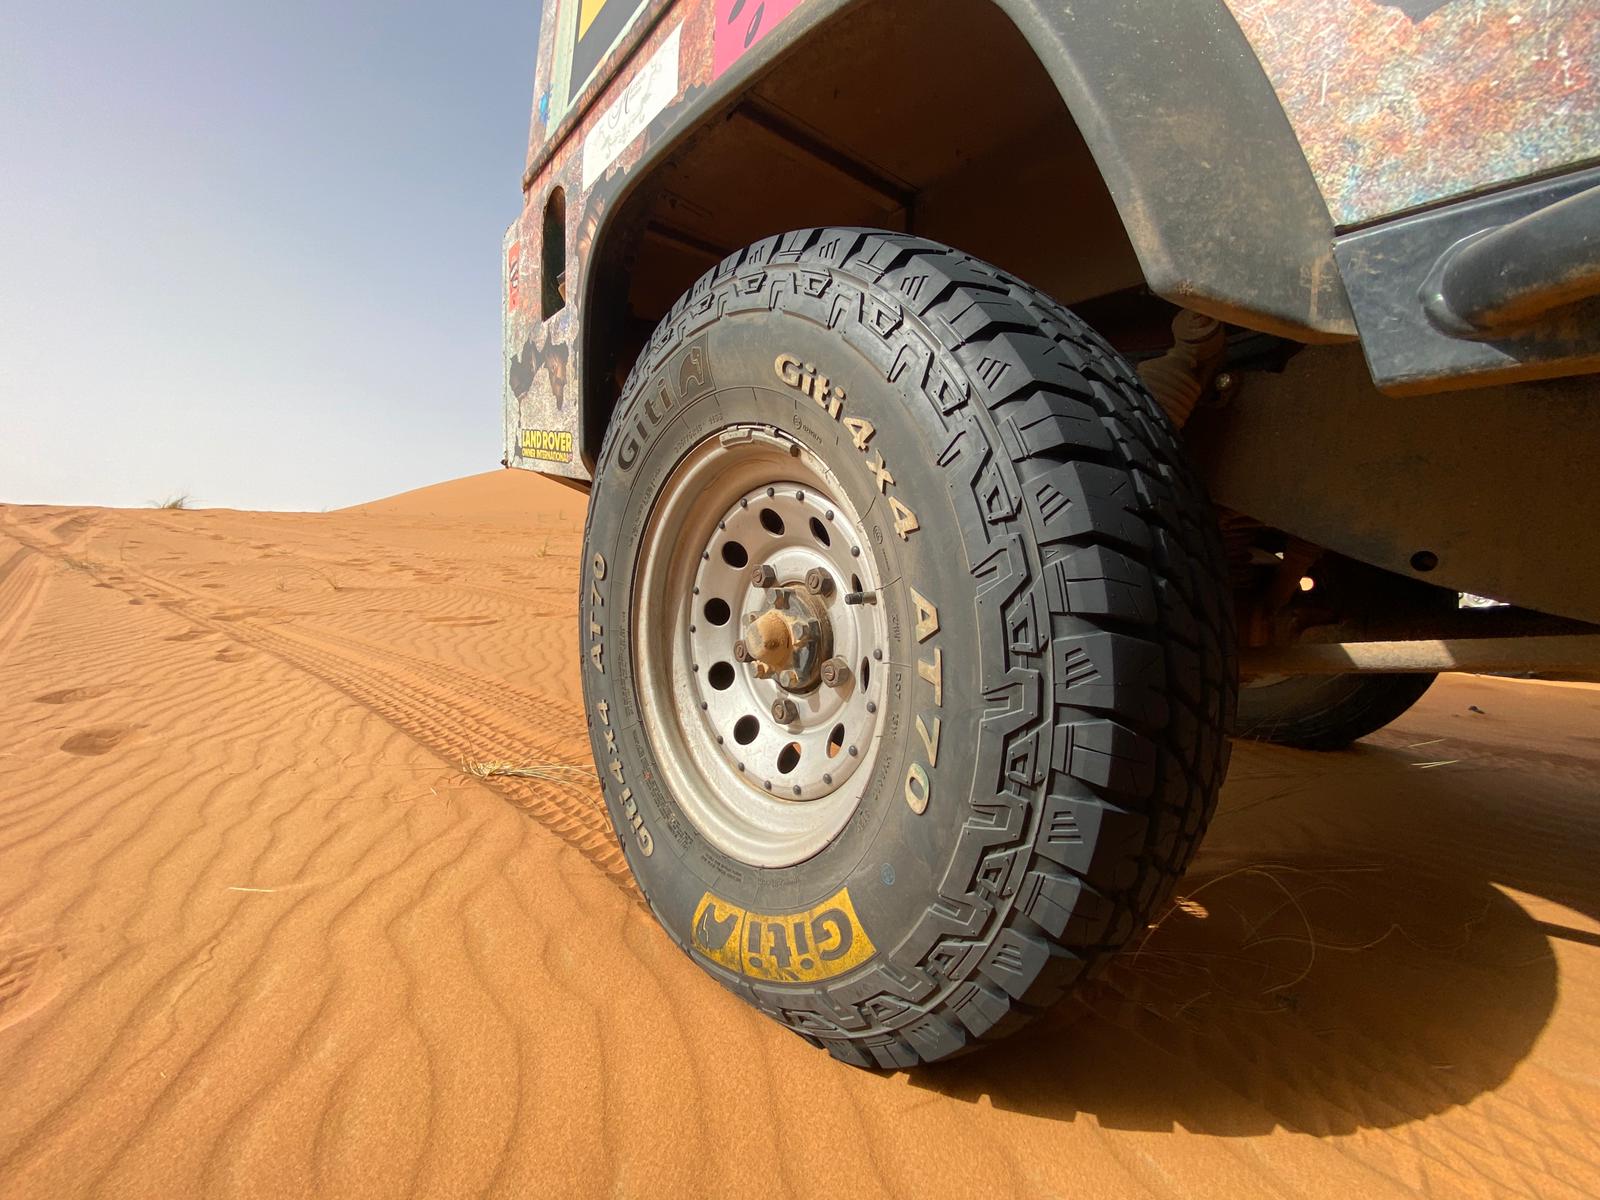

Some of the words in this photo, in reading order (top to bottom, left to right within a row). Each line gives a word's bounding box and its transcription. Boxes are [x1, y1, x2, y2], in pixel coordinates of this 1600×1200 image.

[521, 430, 541, 449] LAND
[542, 431, 572, 452] ROVER
[618, 378, 675, 471] Giti
[590, 552, 608, 674] AT70
[904, 586, 943, 815] AT70
[747, 907, 854, 970] Giti
